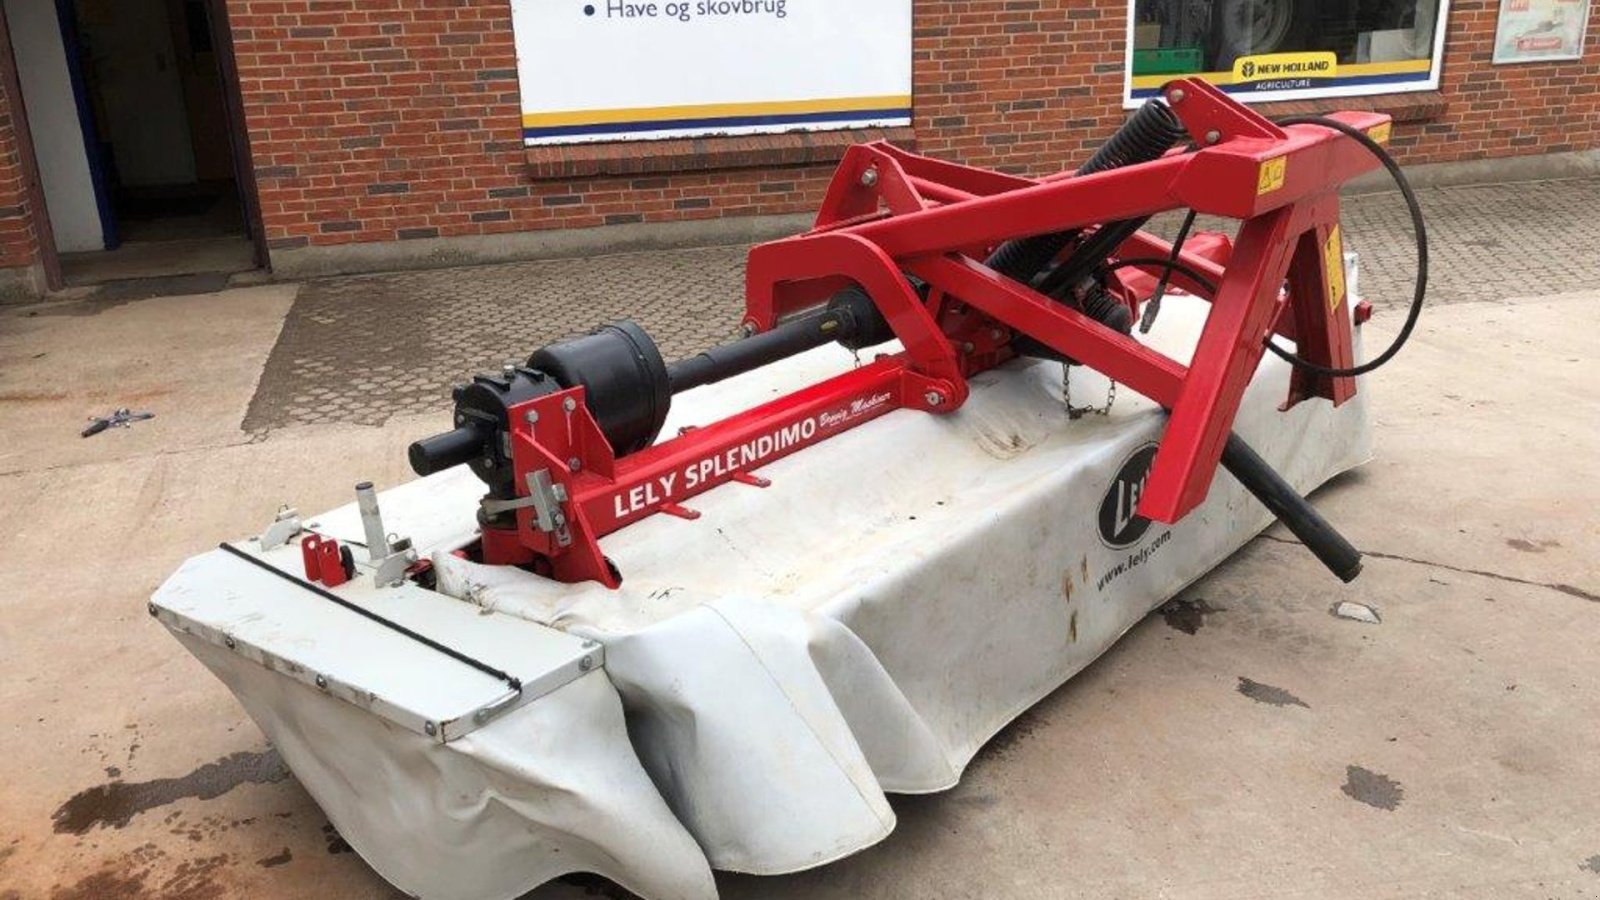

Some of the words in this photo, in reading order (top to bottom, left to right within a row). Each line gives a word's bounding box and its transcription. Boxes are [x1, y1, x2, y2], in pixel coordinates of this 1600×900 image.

[607, 0, 658, 18] Have
[665, 3, 690, 22] og
[697, 0, 787, 19] skovbrug
[1257, 64, 1281, 74] NEW
[1282, 60, 1330, 73] HOLLAND
[1255, 79, 1312, 90] AGRICULTURE
[614, 471, 678, 518] LELY
[685, 416, 816, 489] SPLENDIMO
[1096, 530, 1172, 592] www.lely.com
